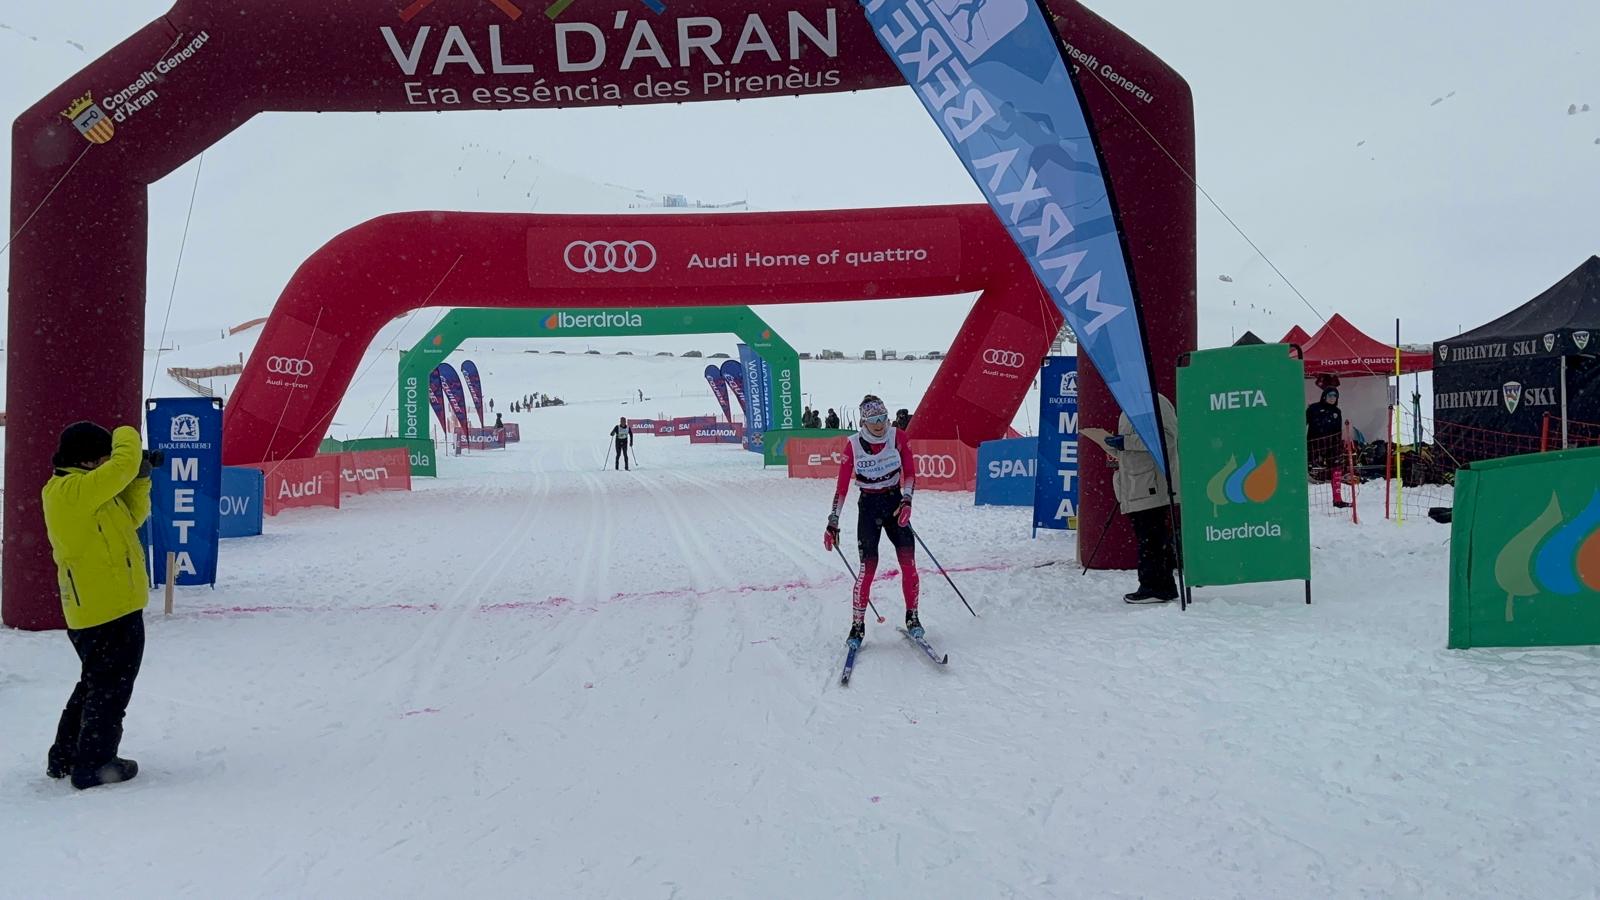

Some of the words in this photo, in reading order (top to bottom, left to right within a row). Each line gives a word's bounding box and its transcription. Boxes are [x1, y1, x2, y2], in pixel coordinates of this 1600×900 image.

[380, 25, 534, 76] VAL
[102, 67, 158, 111] Conselh
[155, 30, 210, 75] Generau
[405, 82, 461, 105] Era
[633, 74, 690, 98] des
[702, 67, 840, 95] Pirenèus
[1100, 64, 1154, 104] Generau
[113, 87, 159, 124] d'Aran
[687, 253, 738, 269] Audi
[744, 251, 811, 267] Home
[816, 249, 839, 264] of
[845, 248, 927, 268] quattro
[557, 311, 643, 330] Iberdrola
[1351, 358, 1362, 366] of
[1452, 343, 1507, 362] IRRINTZI
[1512, 340, 1537, 356] SKI
[266, 378, 283, 387] Audi
[285, 380, 308, 389] e-tron
[404, 377, 417, 439] Iberdrola
[778, 369, 793, 429] Iberdrola
[1210, 390, 1267, 411] META
[1435, 390, 1498, 409] IRRINTZI
[1524, 387, 1556, 405] SKI
[695, 429, 736, 437] SALOMON
[988, 459, 1036, 478] SPAI
[278, 477, 323, 500] Audi
[171, 457, 198, 576] META
[1205, 521, 1281, 542] Iberdrola
